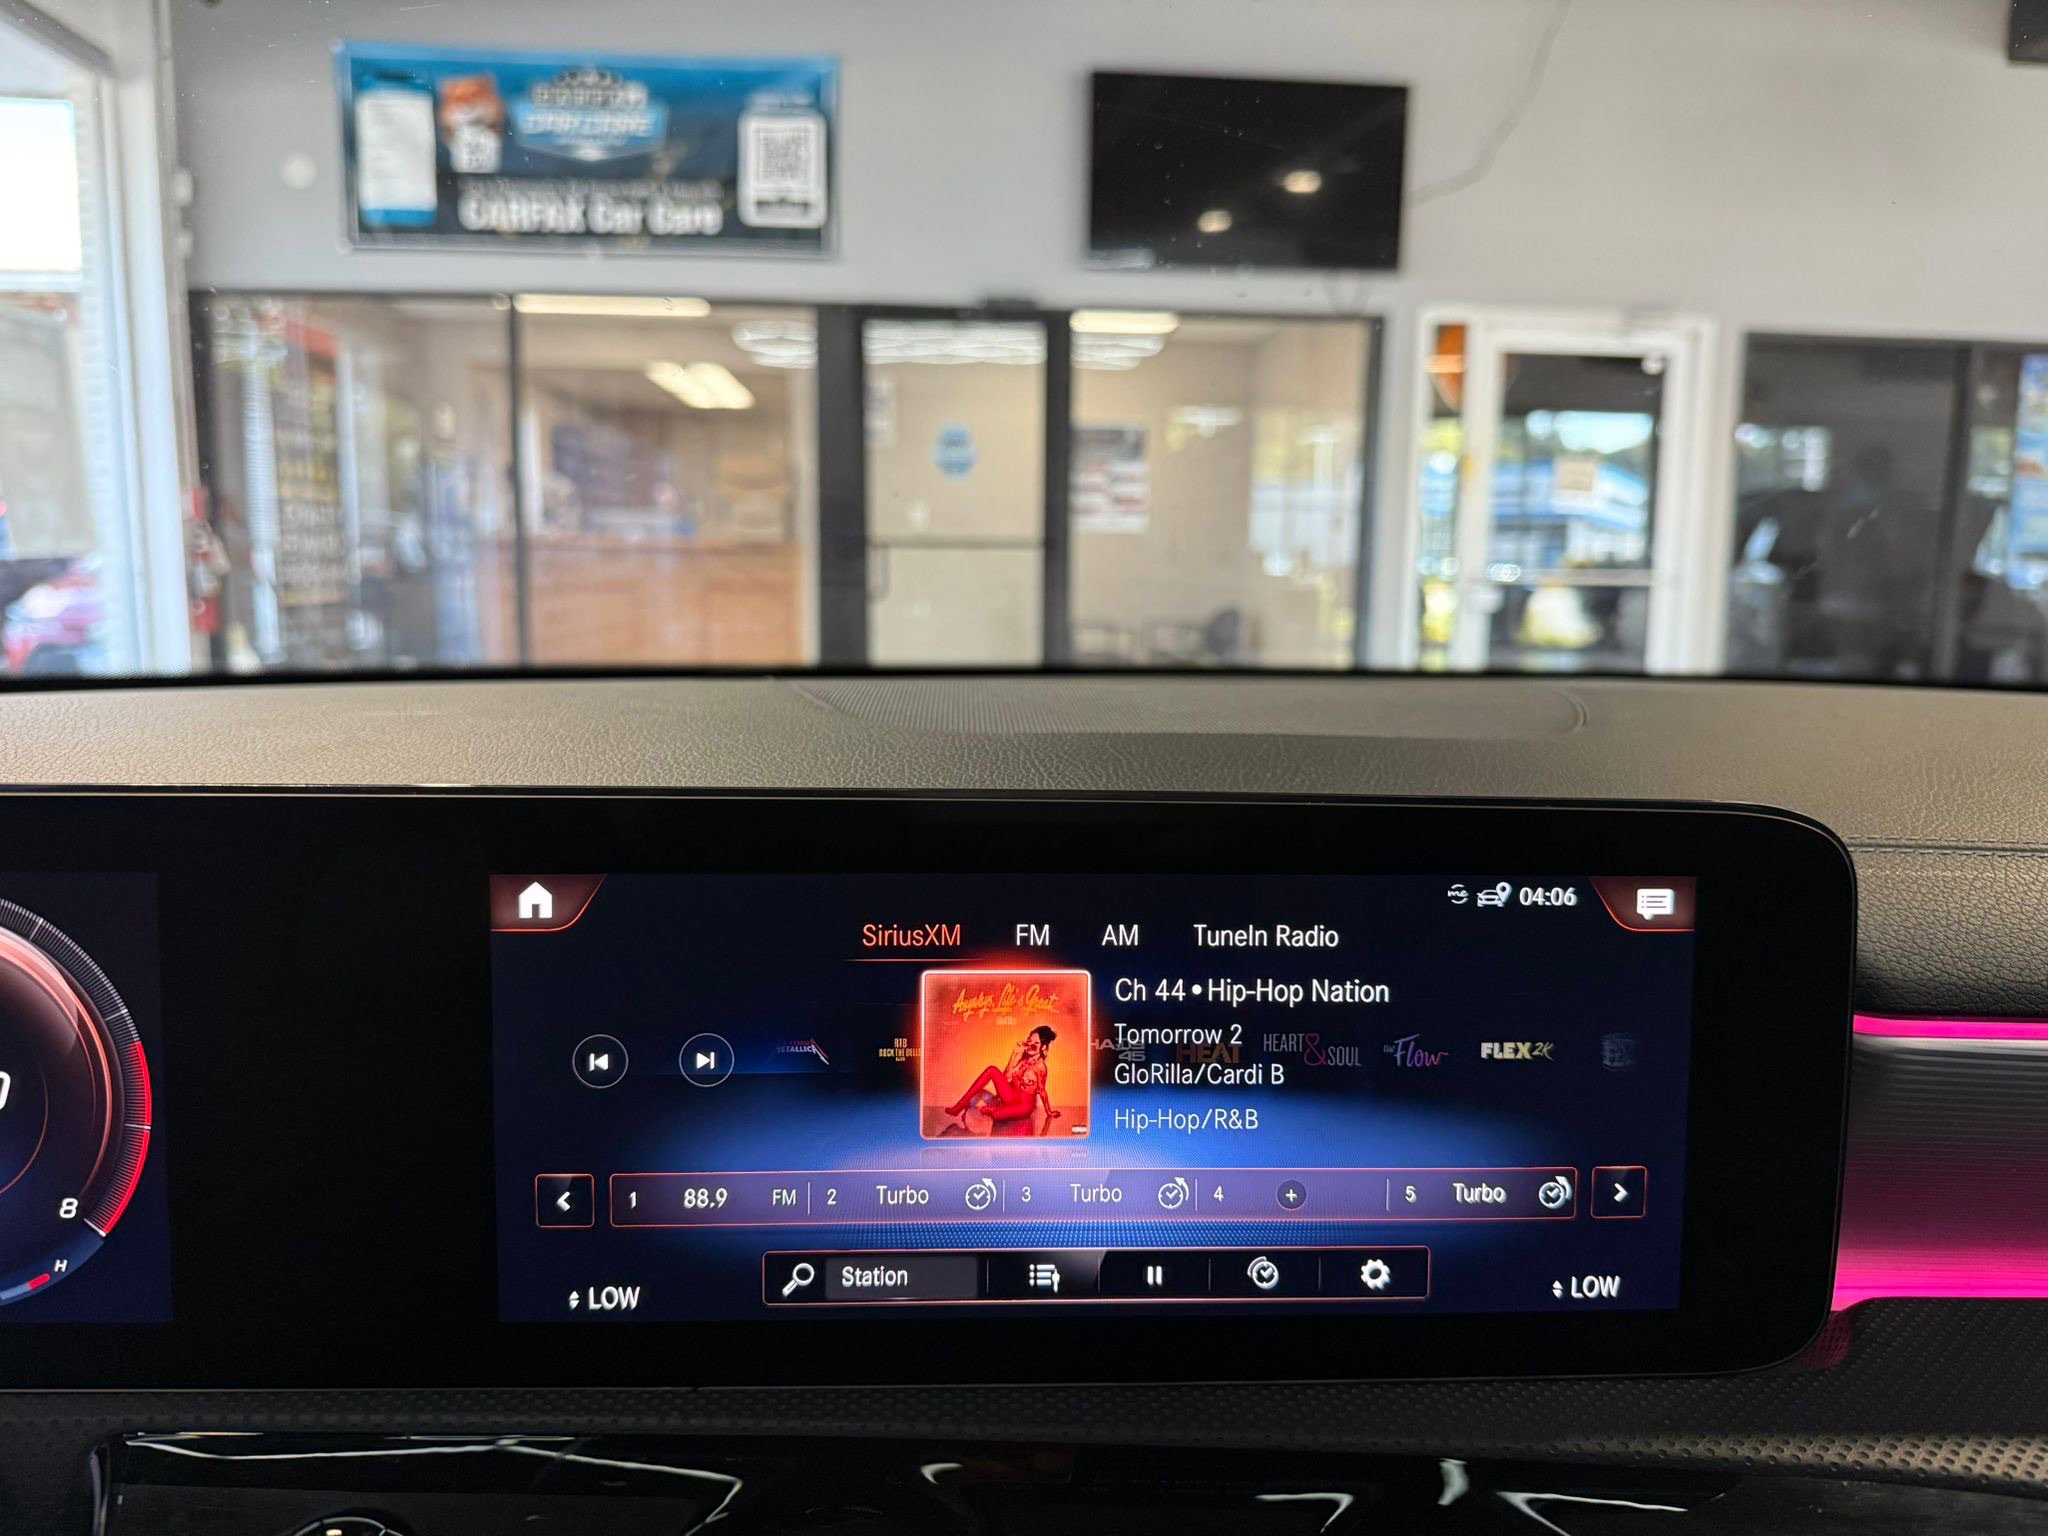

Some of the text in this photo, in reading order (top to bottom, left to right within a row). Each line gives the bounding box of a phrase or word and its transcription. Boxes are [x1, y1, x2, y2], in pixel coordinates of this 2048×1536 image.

[1519, 887, 1577, 906] 04:06
[862, 924, 961, 947] SiriusXM
[1015, 924, 1050, 946] FM
[1101, 924, 1139, 946] AM
[1193, 924, 1339, 948] TuneIn Radio
[1115, 978, 1390, 1008] Ch 44 Hip-Hop Nation
[1114, 1023, 1243, 1045] Tomorrow 2
[1263, 1033, 1305, 1052] HEART
[1328, 1046, 1361, 1066] SOUL
[1393, 1033, 1449, 1068] Flow
[1480, 1041, 1533, 1060] FLEX
[1114, 1063, 1285, 1085] GloRilla/Cardi B
[1114, 1108, 1259, 1134] Hip-Hop/R&B
[629, 1191, 637, 1209] 1
[683, 1188, 797, 1209] 88.9 FM
[826, 1189, 837, 1205] 2
[876, 1185, 929, 1205] Turbo
[1021, 1187, 1032, 1203] 3
[1070, 1184, 1122, 1204] Turbo
[1213, 1186, 1225, 1202] 4
[1405, 1186, 1417, 1202] 5
[1453, 1183, 1507, 1204] Turbo
[59, 1198, 78, 1218] 8
[54, 1259, 67, 1272] H
[841, 1265, 908, 1288] Station
[1571, 1275, 1621, 1298] LOW
[588, 1286, 640, 1311] LOW
